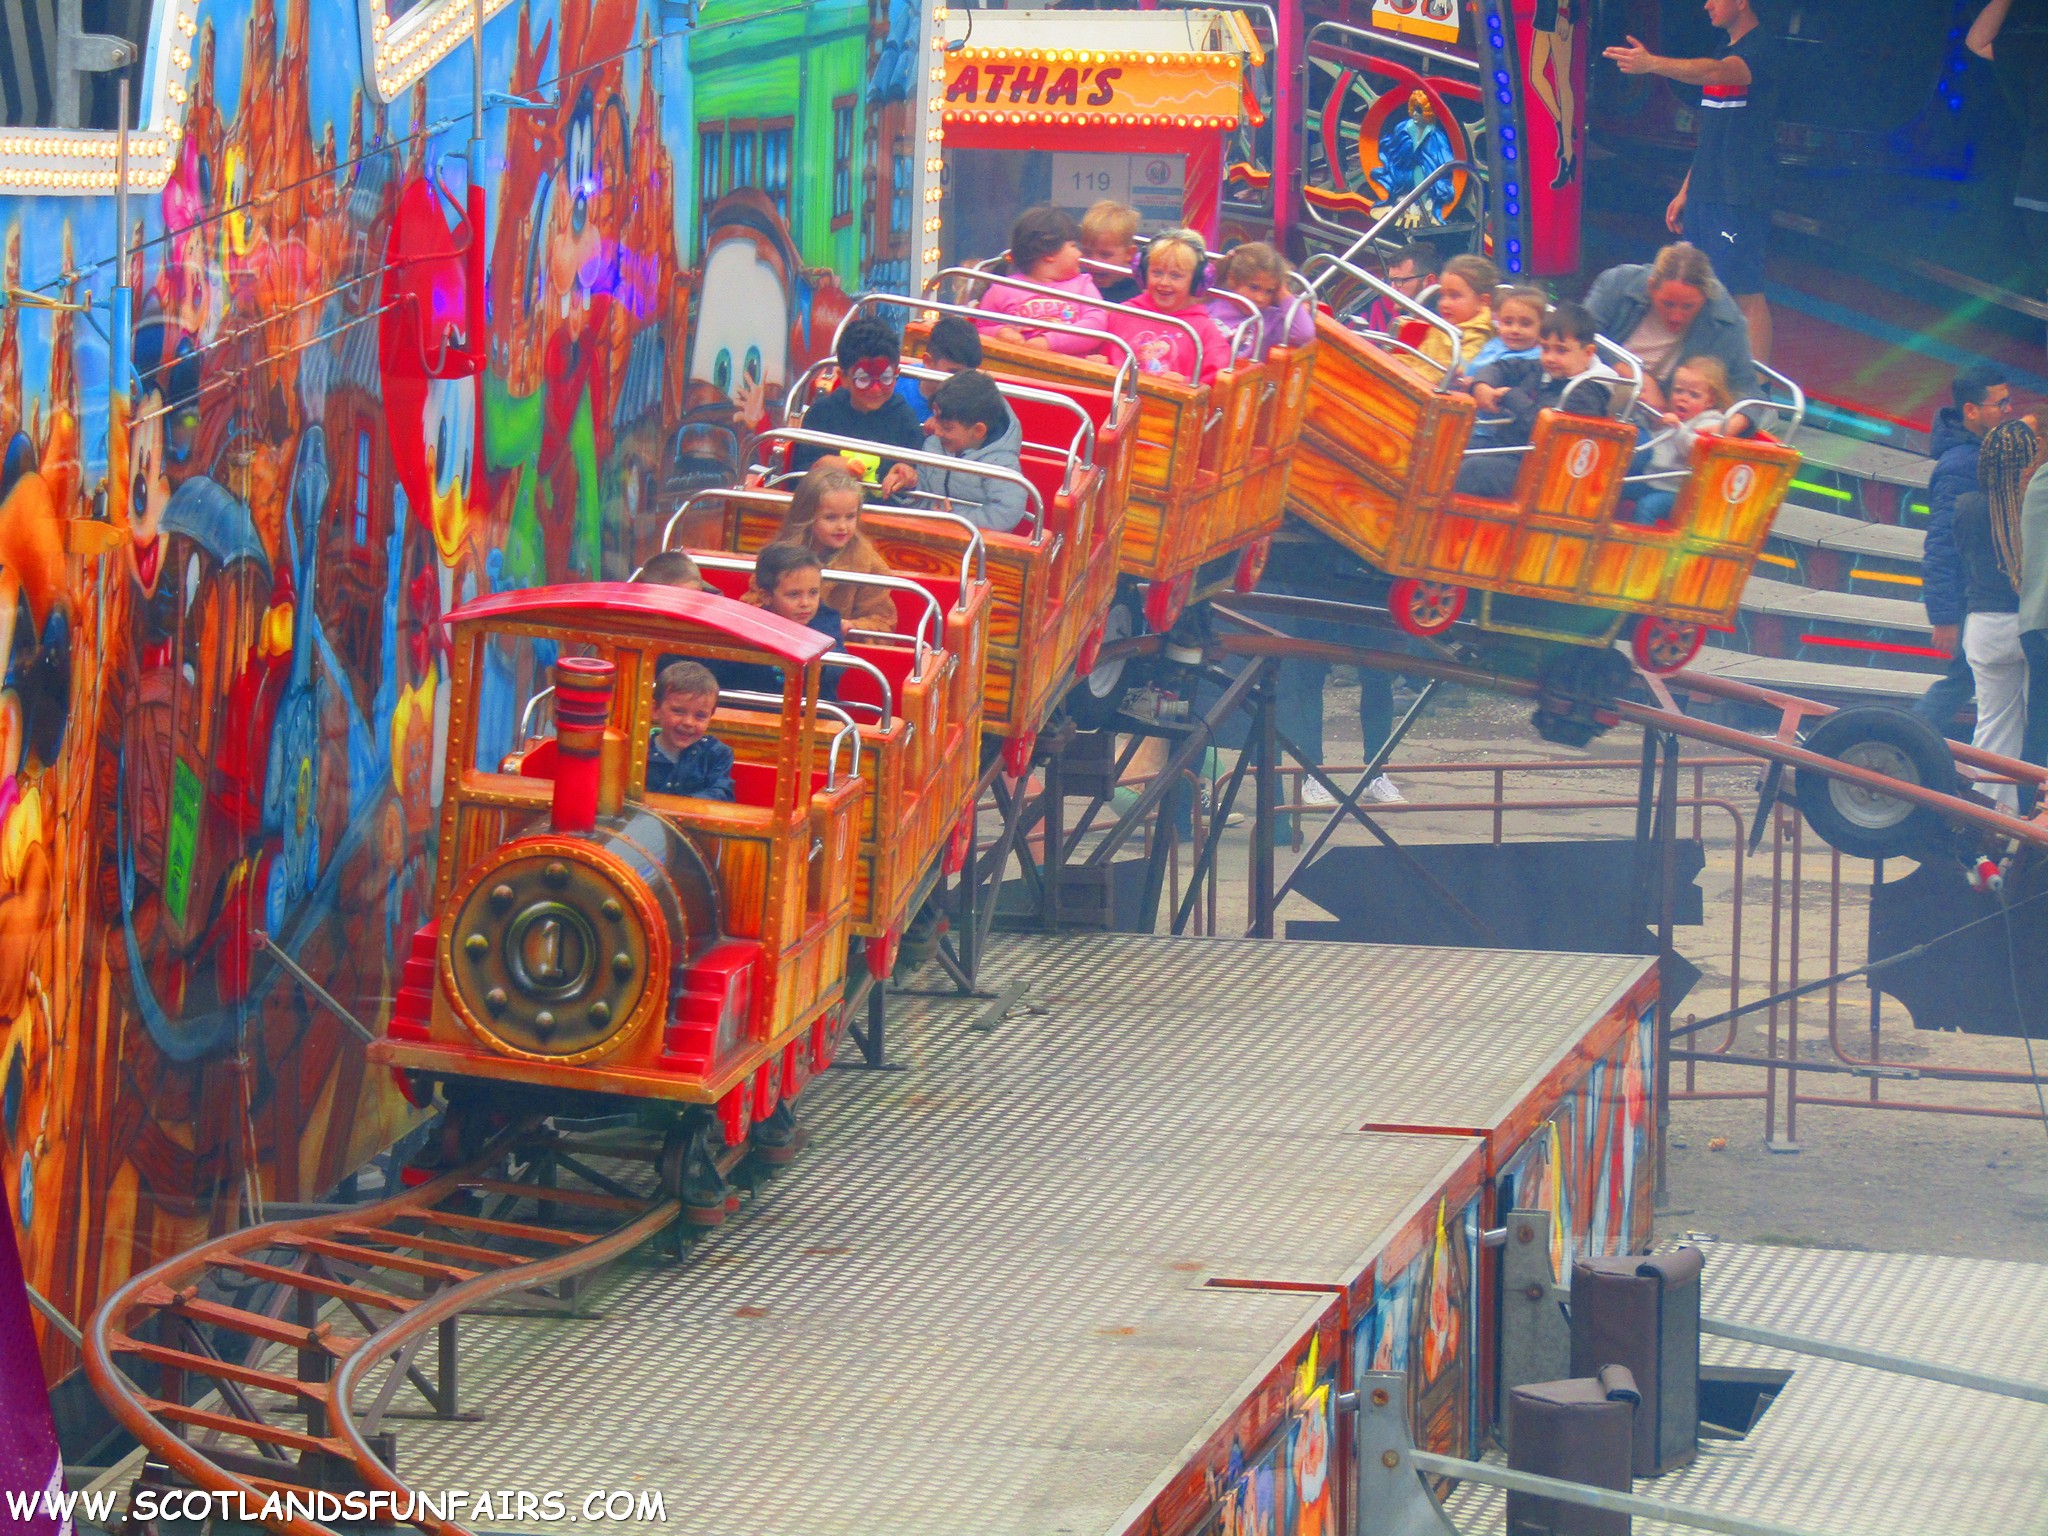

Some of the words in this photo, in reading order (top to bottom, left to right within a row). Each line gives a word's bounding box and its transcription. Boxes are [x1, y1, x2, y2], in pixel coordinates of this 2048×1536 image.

[945, 65, 1122, 106] ATHA'S
[1072, 171, 1110, 191] 119
[1574, 441, 1591, 475] 8
[1732, 467, 1749, 501] 9
[540, 920, 563, 976] 1
